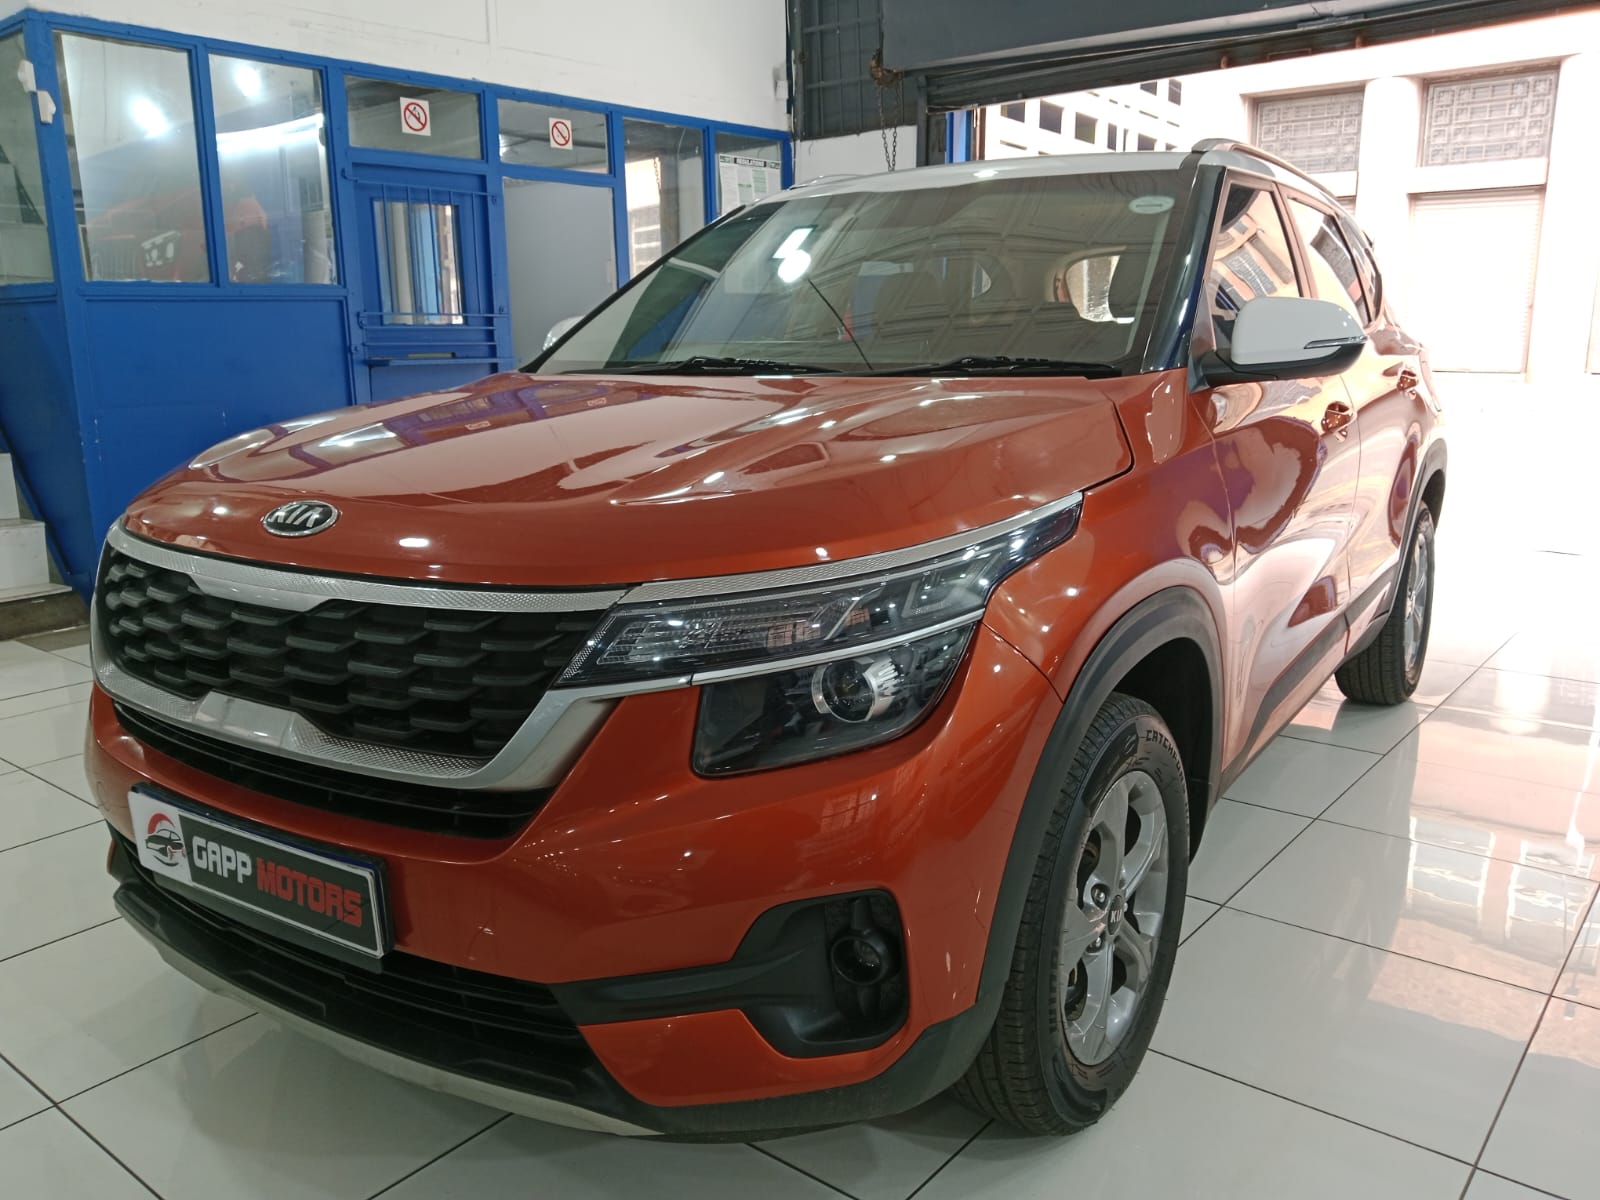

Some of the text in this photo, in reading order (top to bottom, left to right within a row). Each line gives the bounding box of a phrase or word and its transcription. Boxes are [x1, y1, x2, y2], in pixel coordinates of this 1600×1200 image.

[268, 504, 324, 528] KIA
[192, 836, 362, 927] GAPP MOTORS
